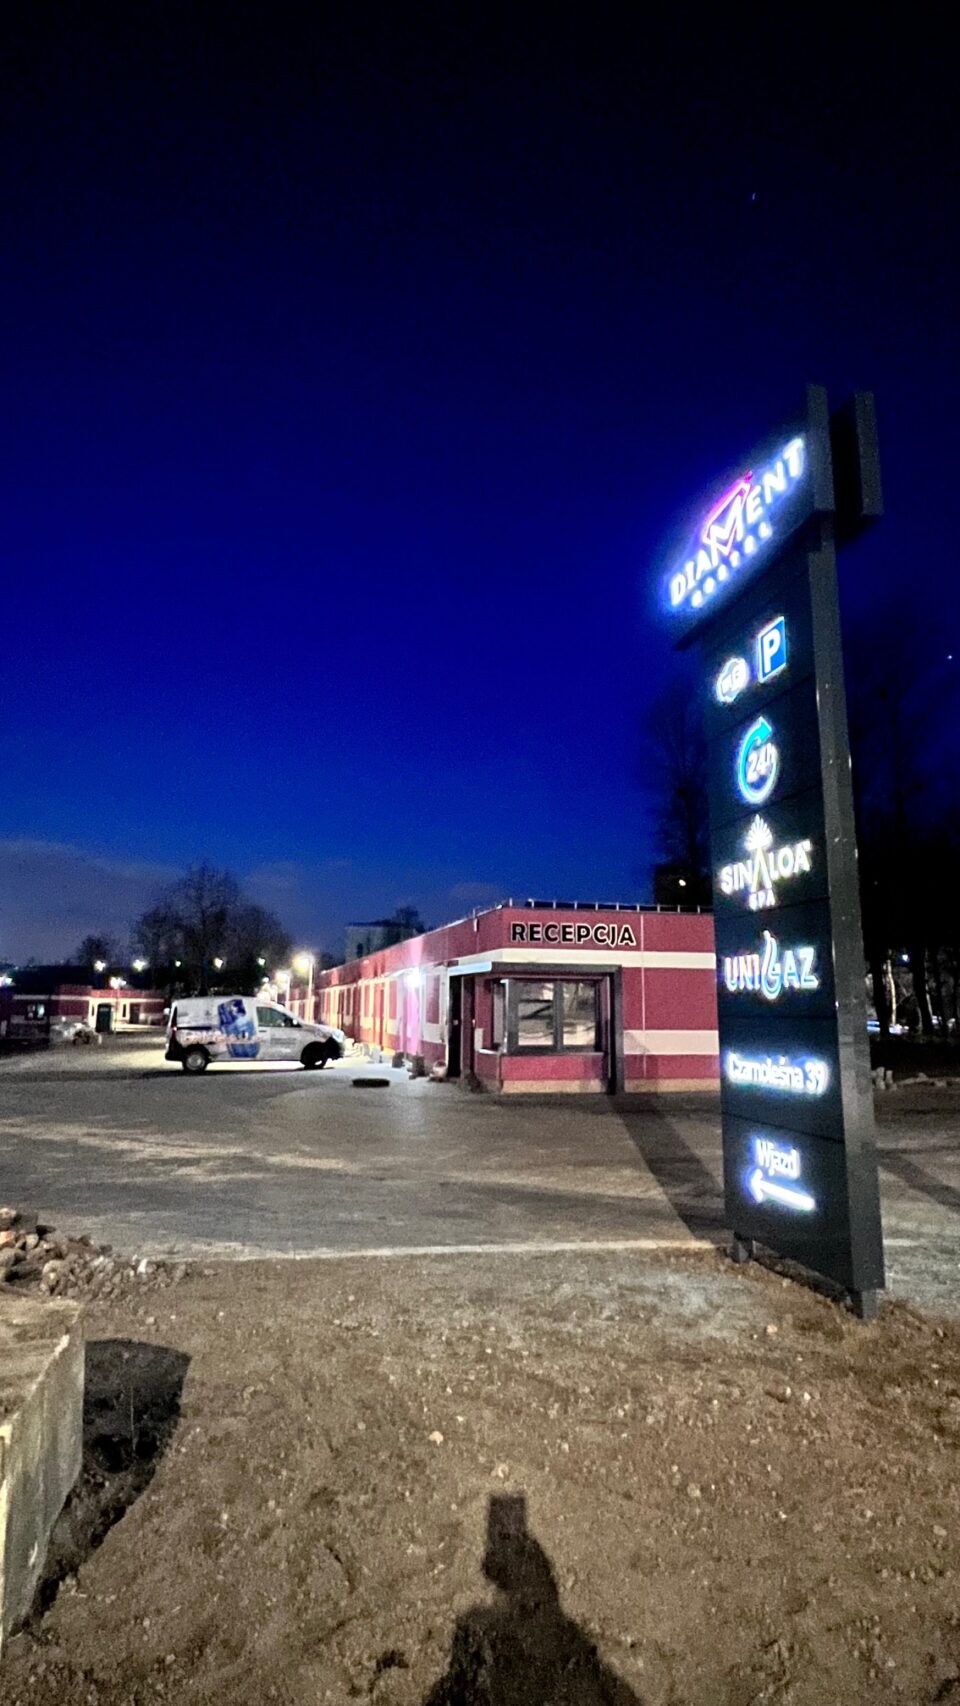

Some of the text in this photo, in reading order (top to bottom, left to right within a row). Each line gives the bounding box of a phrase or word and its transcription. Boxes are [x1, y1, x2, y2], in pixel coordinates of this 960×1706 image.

[670, 437, 805, 607] DIAMENT
[763, 628, 780, 674] P
[720, 843, 811, 894] SINALOA
[749, 889, 776, 910] SPA
[511, 922, 637, 947] RECEPCJA
[805, 1061, 828, 1094] 39
[756, 1139, 800, 1177] Wjazd
